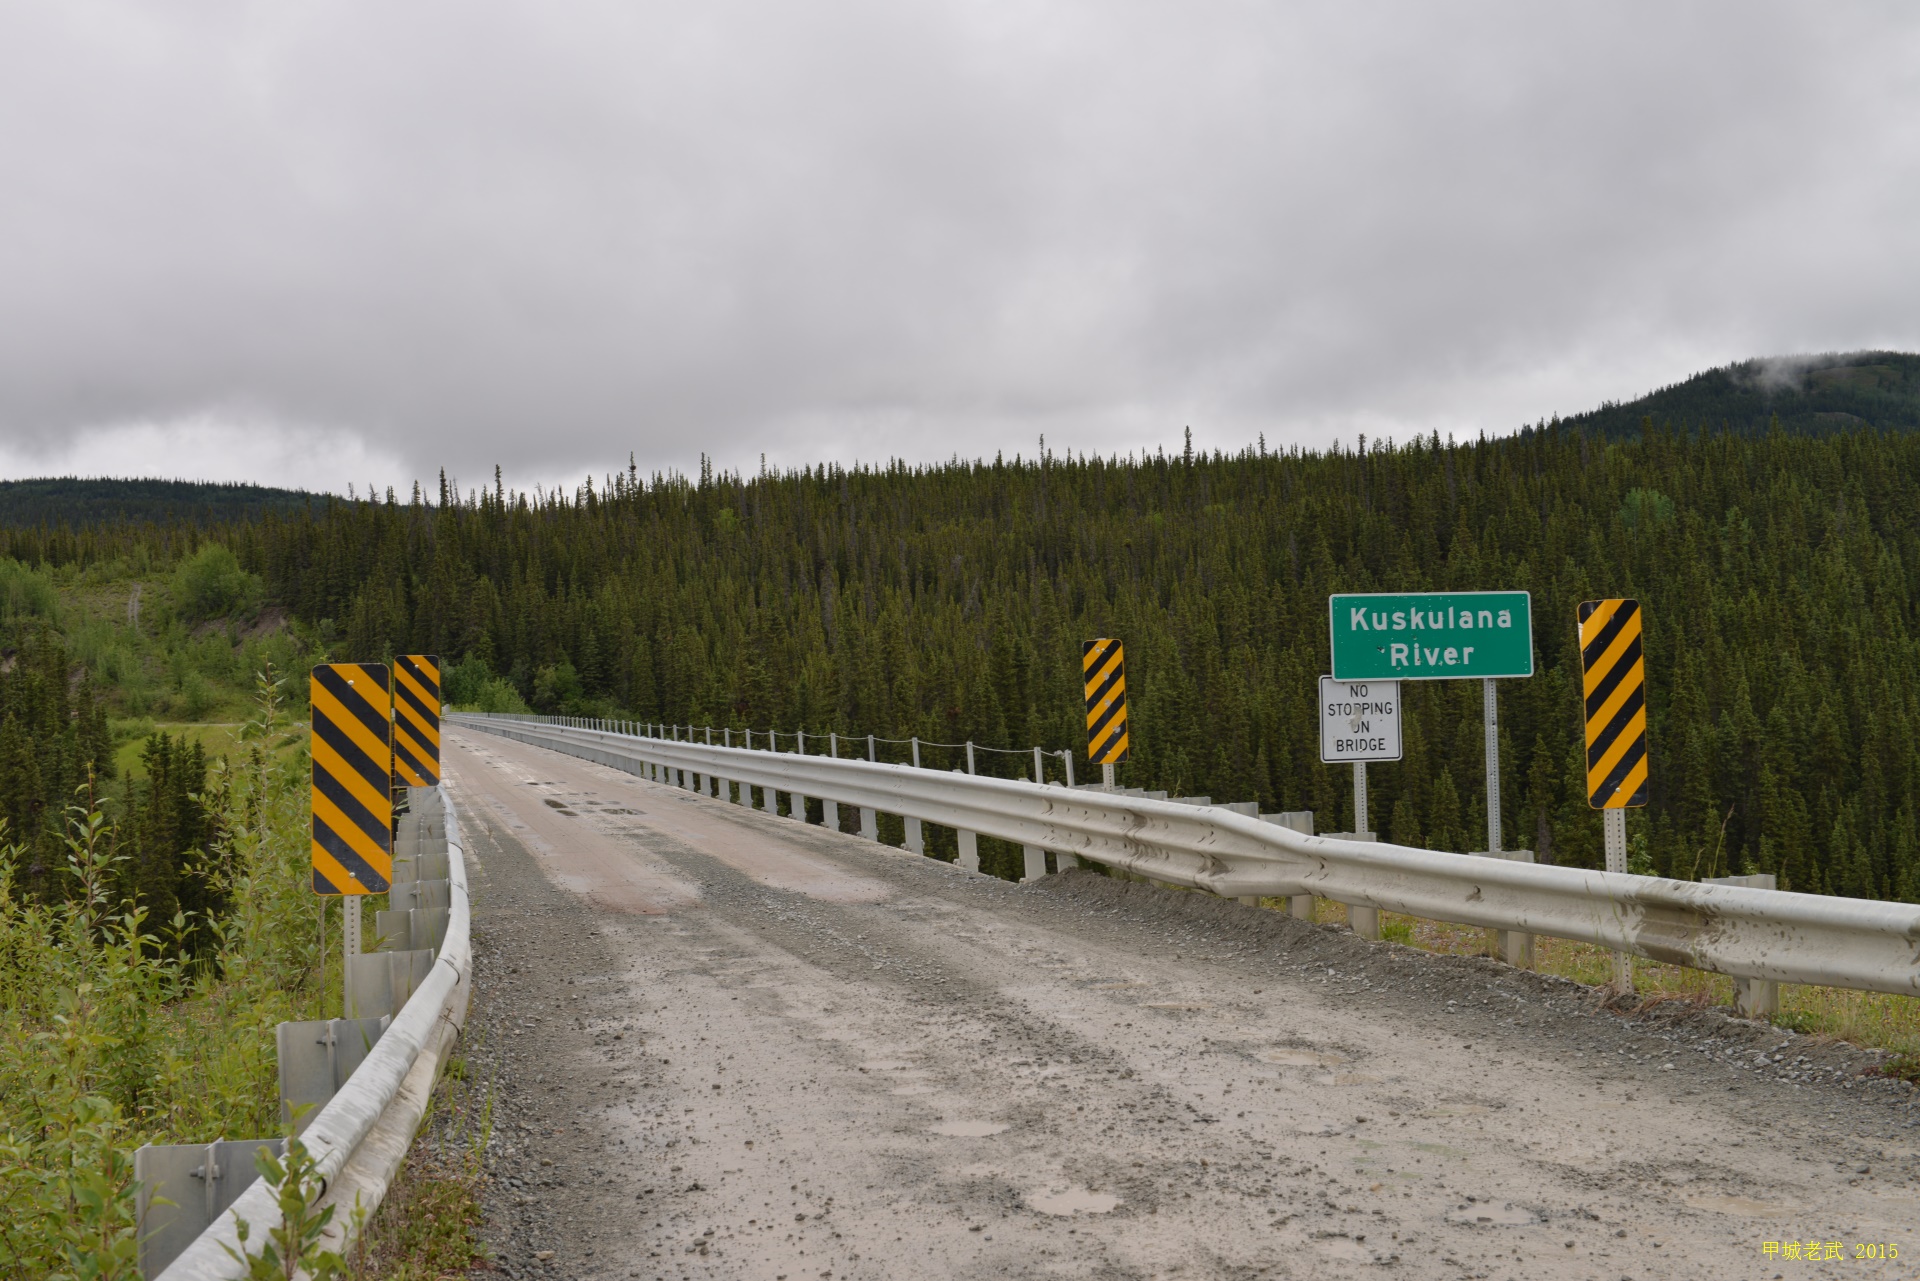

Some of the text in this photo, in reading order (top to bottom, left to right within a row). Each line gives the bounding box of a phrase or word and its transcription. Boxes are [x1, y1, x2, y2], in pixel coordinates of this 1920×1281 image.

[1350, 606, 1512, 631] Kuskulana
[1391, 643, 1475, 667] River
[1350, 684, 1368, 698] NO
[1336, 738, 1386, 752] BRIDGE
